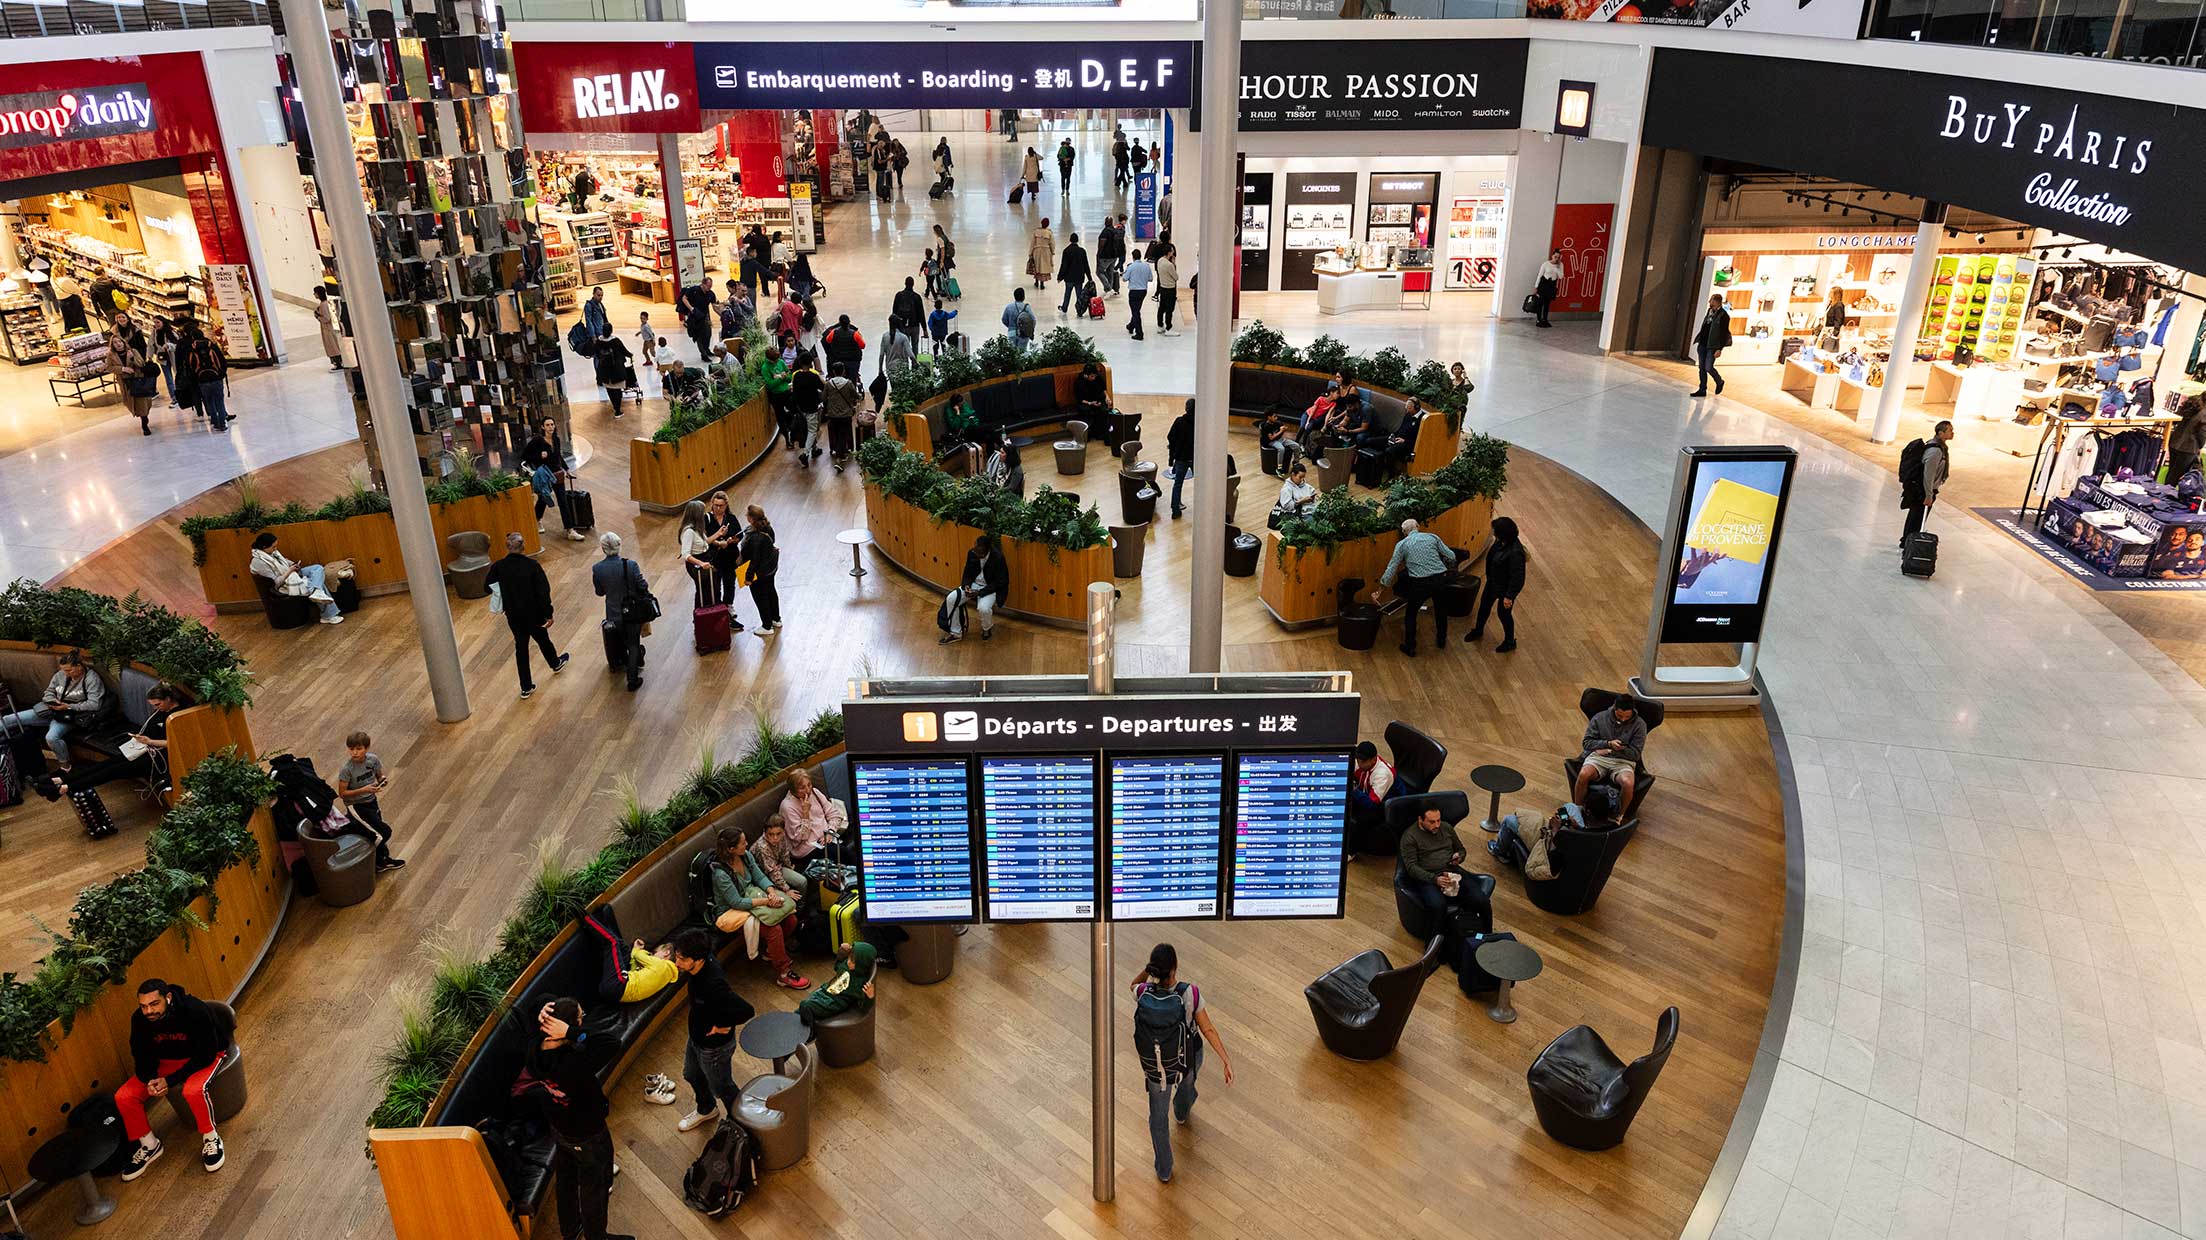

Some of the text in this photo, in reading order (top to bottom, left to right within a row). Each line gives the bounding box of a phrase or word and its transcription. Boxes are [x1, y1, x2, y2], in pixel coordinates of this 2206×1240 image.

[1725, 0, 1750, 28] BAR
[746, 70, 902, 92] Embarquement
[922, 71, 1013, 92] Boarding
[1034, 69, 1073, 89] 登机
[1081, 59, 1111, 91] D,
[1120, 59, 1148, 91] E,
[1157, 59, 1174, 87] F
[1239, 73, 1478, 99] HOUR PASSION
[1250, 111, 1277, 119] RADO
[1325, 110, 1361, 118] BALMAIN
[1374, 109, 1399, 117] MIDO
[2034, 103, 2152, 174] PARIS
[1301, 184, 1341, 193] LONGINES
[2025, 172, 2132, 226] Collection
[2093, 491, 2103, 504] TU
[2101, 496, 2112, 509] ES
[1692, 523, 1766, 535] L'OCCITANE
[1700, 534, 1767, 545] PROVENCE
[985, 717, 1077, 738] Départs
[1102, 716, 1233, 737] Departures
[1258, 714, 1298, 732] 出发
